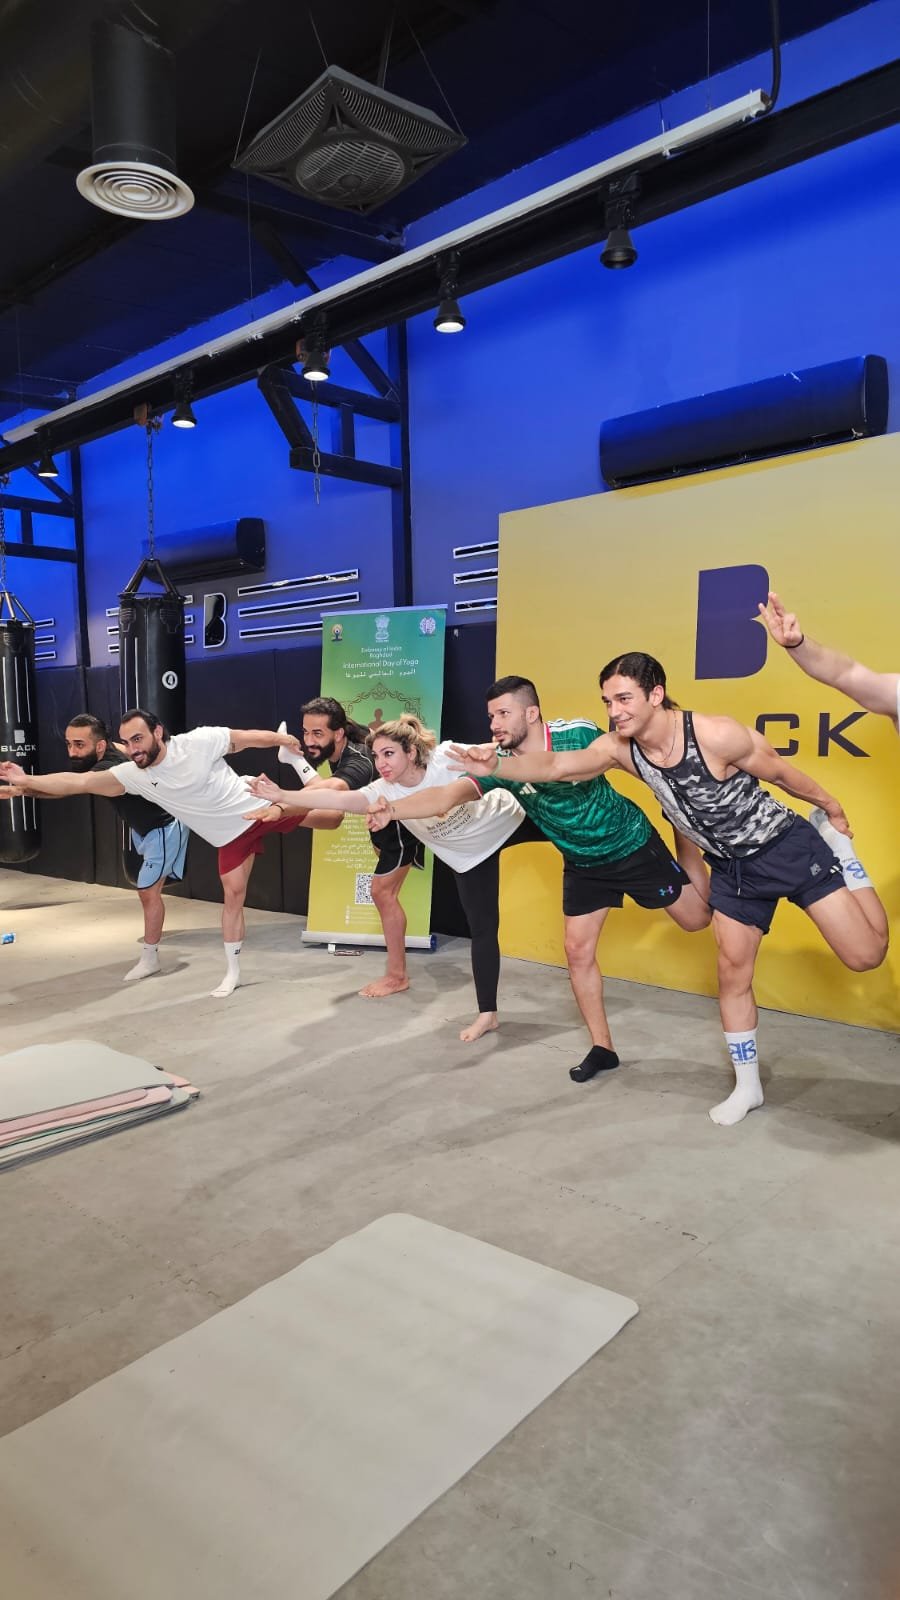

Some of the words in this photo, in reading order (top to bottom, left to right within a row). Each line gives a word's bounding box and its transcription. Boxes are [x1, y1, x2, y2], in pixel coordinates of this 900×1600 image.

[343, 660, 382, 669] International
[382, 660, 395, 668] Day
[402, 659, 419, 667] Yoga
[0, 744, 36, 752] BLACK
